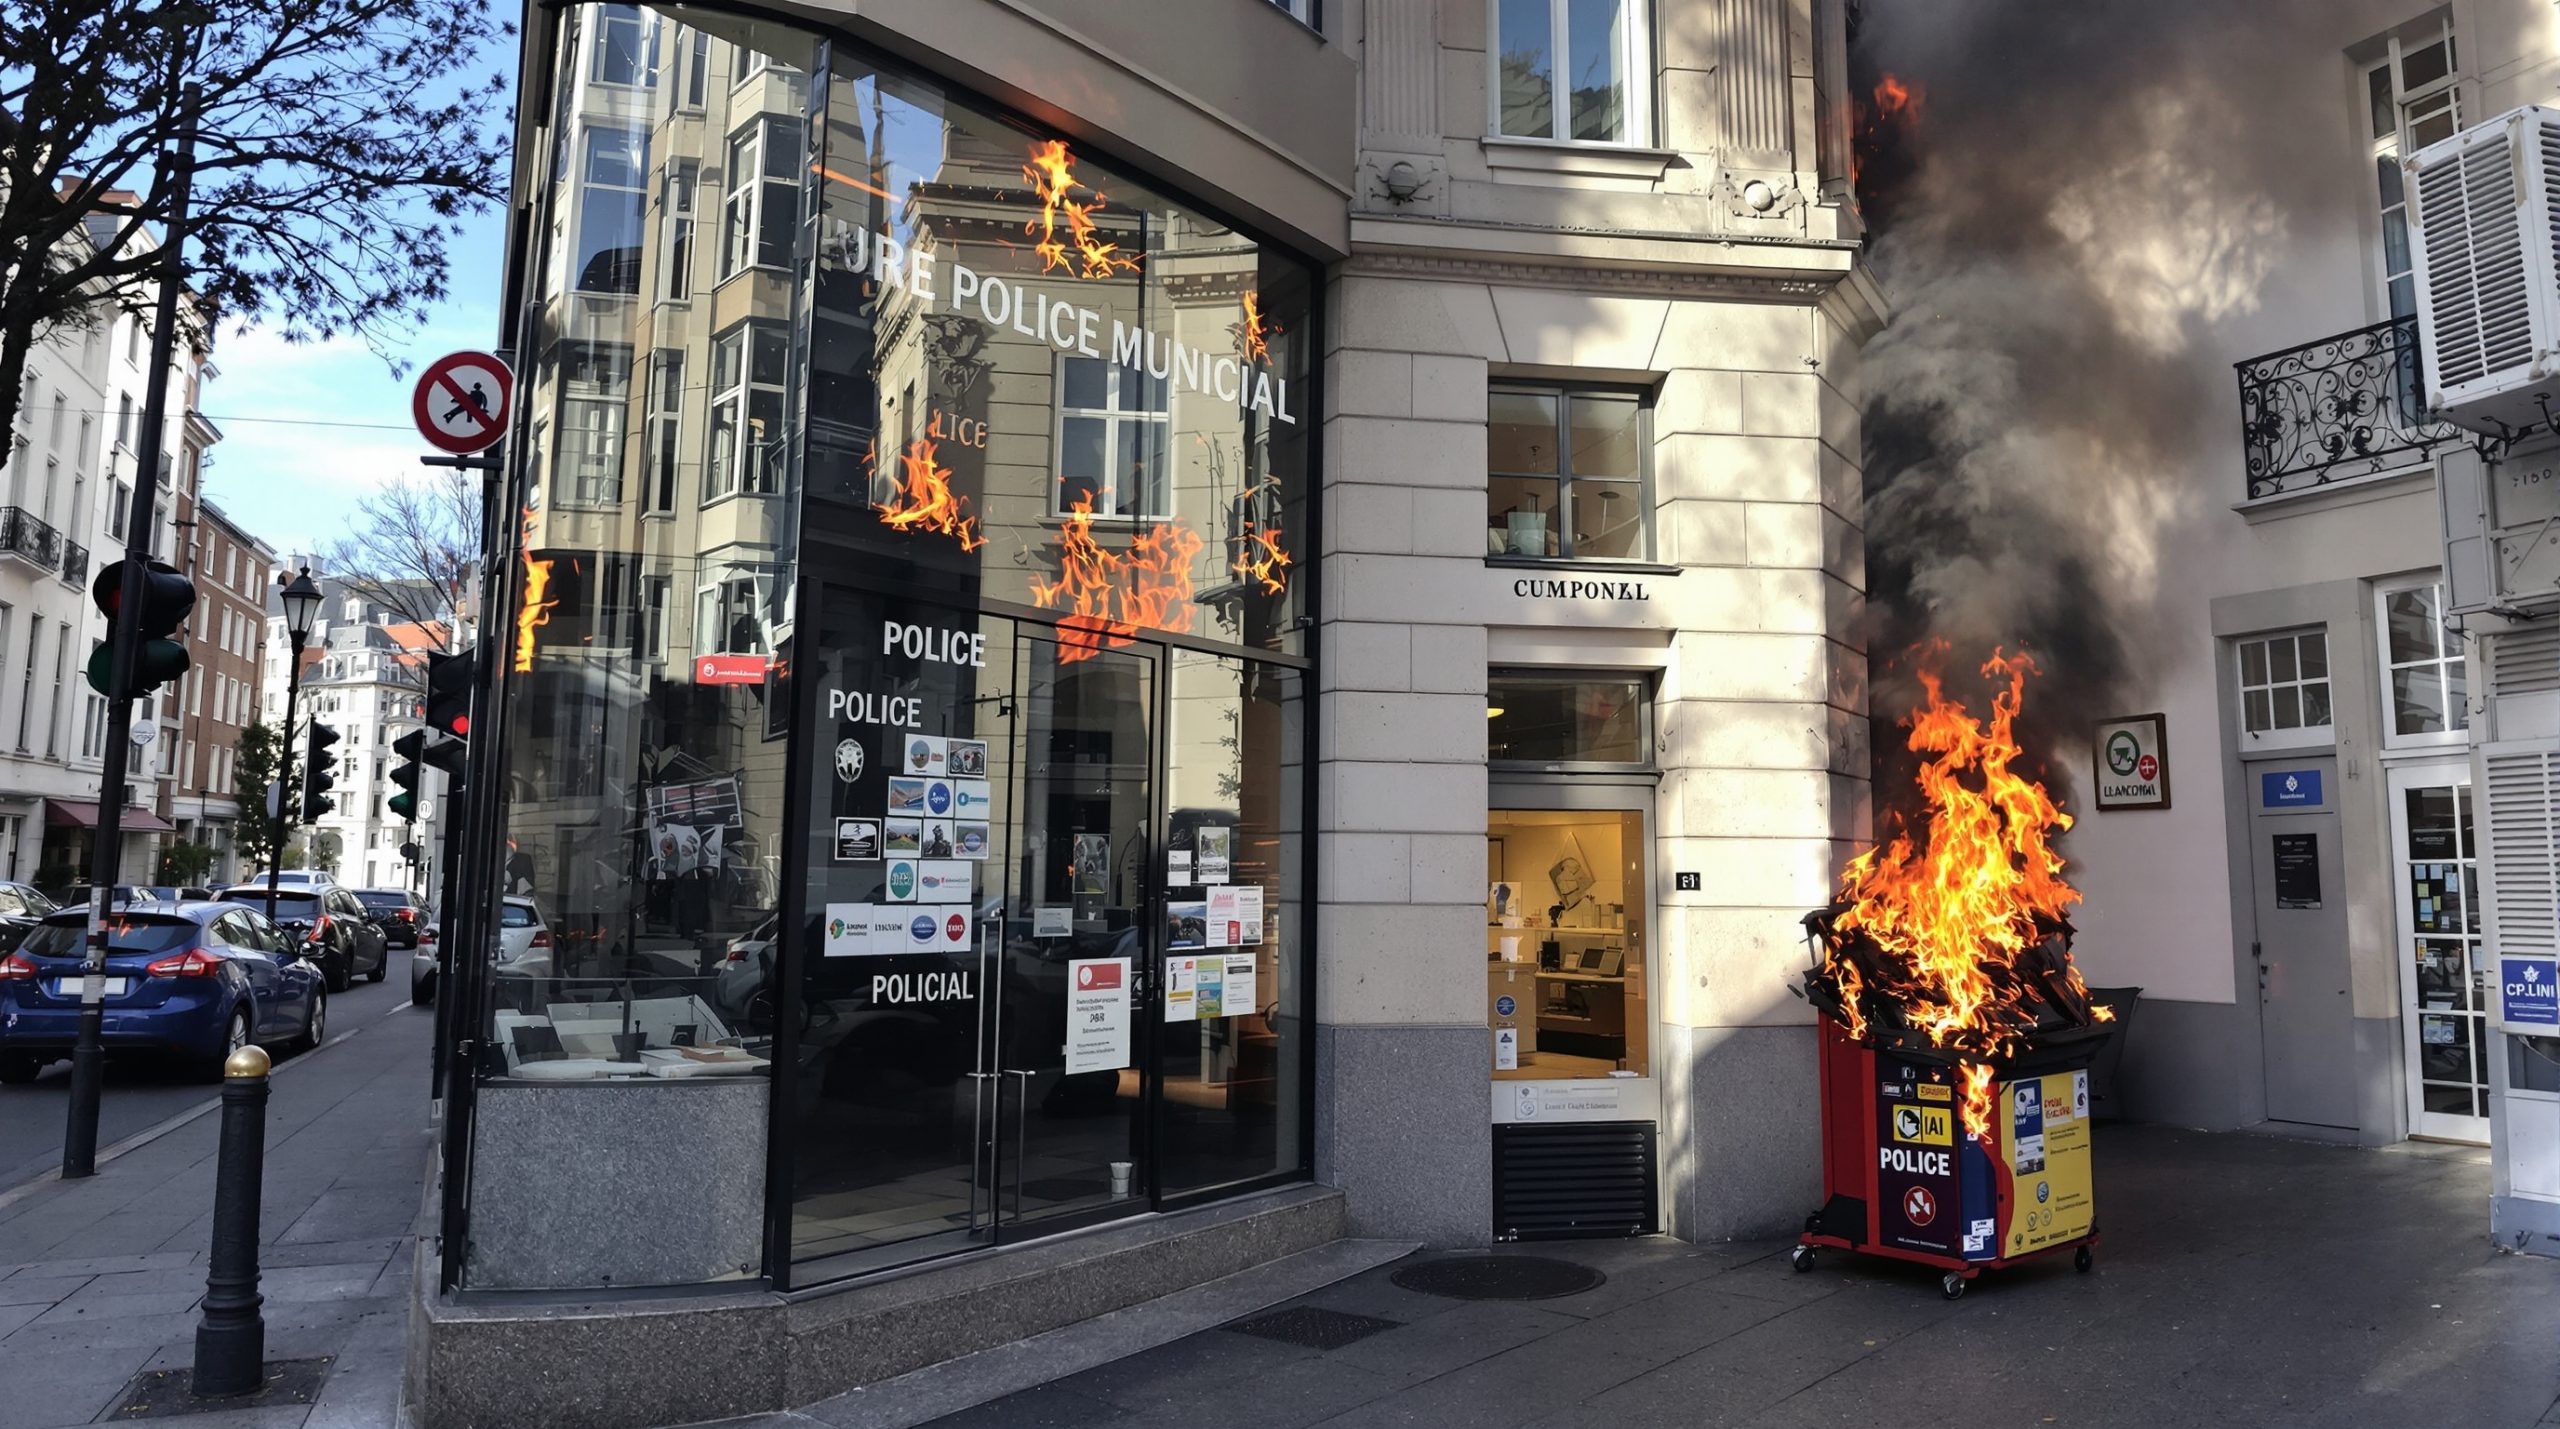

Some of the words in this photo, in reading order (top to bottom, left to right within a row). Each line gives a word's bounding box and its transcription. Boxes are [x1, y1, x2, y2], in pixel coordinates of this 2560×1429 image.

[953, 264, 1100, 359] POLICE
[1111, 319, 1296, 425] MUNICIAL
[883, 620, 986, 668] POLICE
[829, 688, 922, 728] POLICE
[872, 971, 974, 1004] POLICIAL
[1880, 1147, 1951, 1177] POLICE
